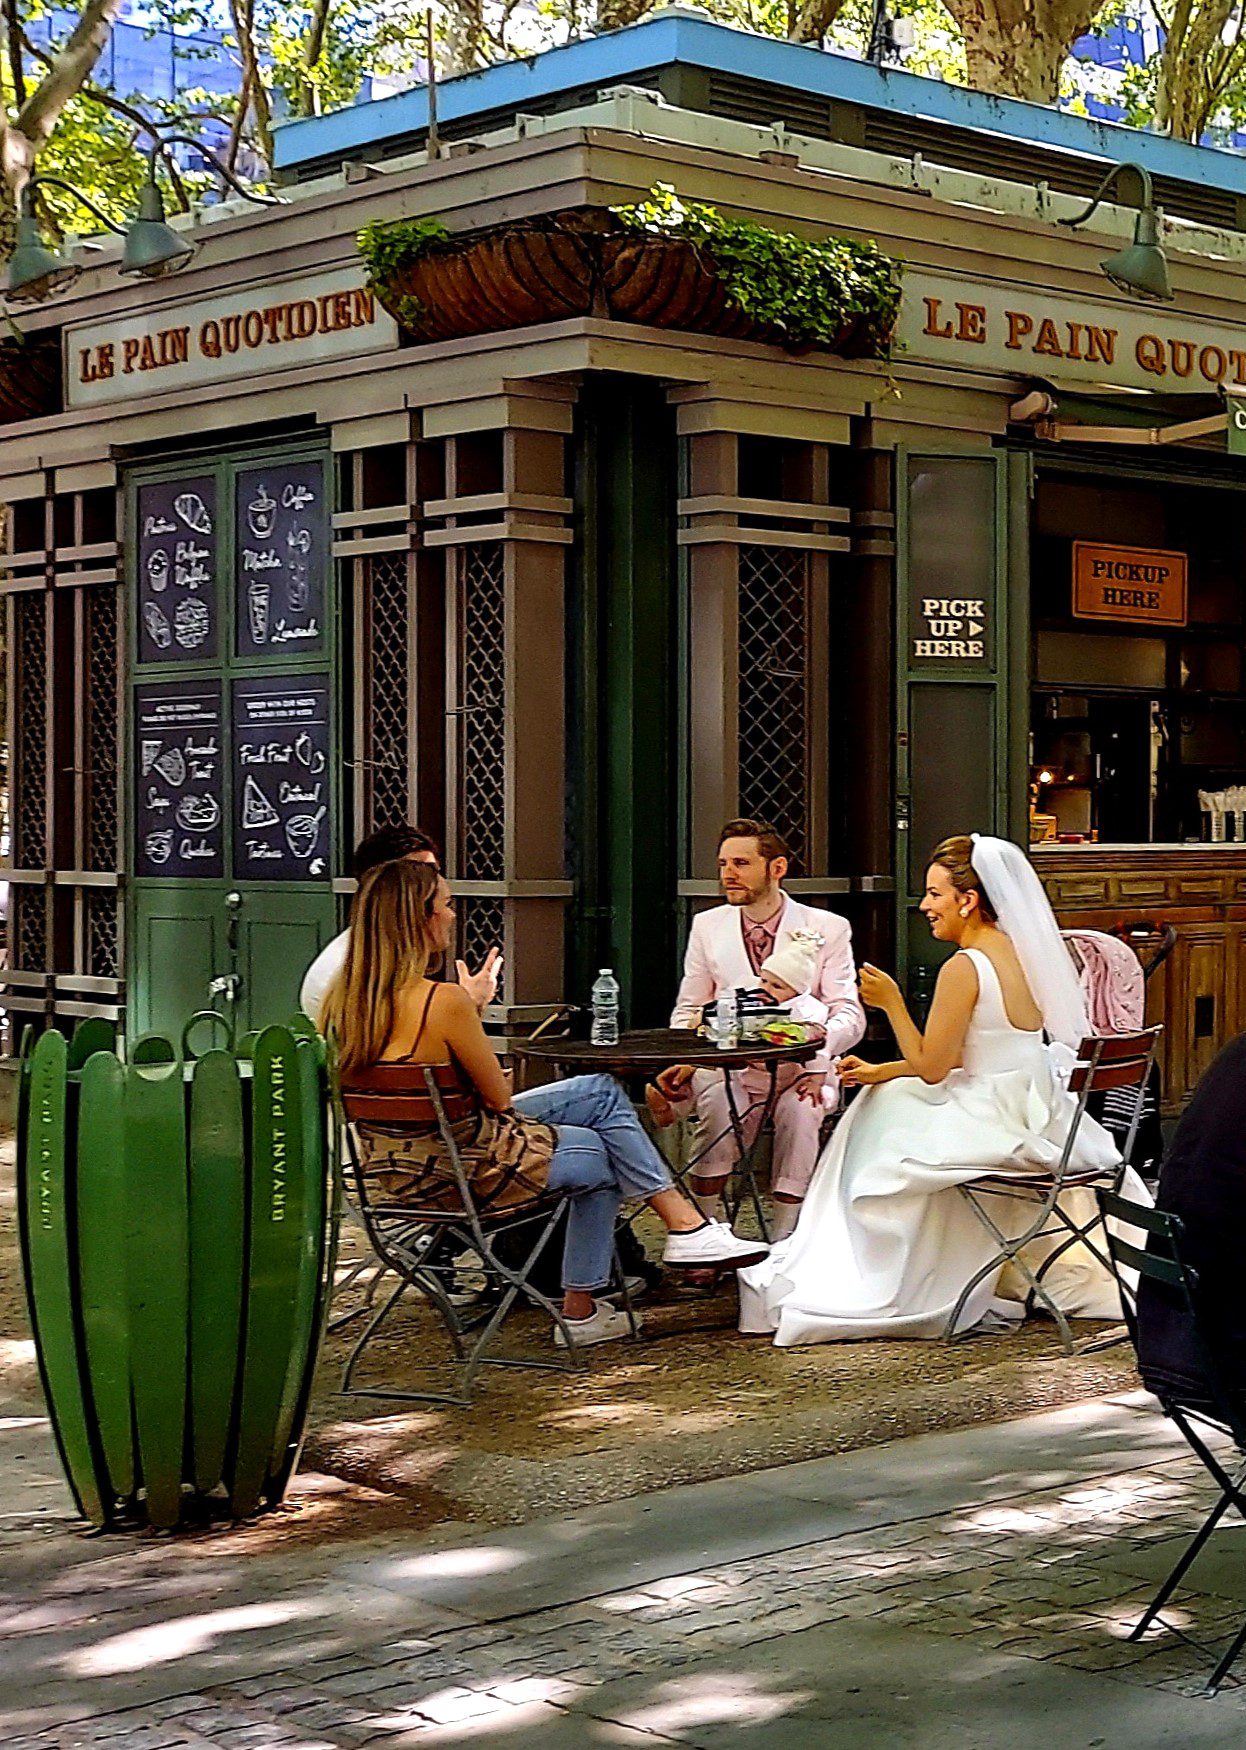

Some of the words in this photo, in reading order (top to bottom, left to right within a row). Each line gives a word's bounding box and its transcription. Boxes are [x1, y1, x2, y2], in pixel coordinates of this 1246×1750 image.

[80, 343, 114, 383] LE
[122, 326, 190, 374] PAIN
[200, 288, 376, 359] QUOTIDIEN
[922, 297, 987, 343] LE
[1005, 311, 1118, 364] PAIN
[1091, 559, 1170, 584] PICKUP
[922, 599, 985, 617] PICK
[1102, 587, 1161, 610] HERE
[928, 619, 964, 637] UP
[914, 640, 984, 658] HERE
[271, 1055, 285, 1117] PARK
[272, 1128, 286, 1221] BRYANT
